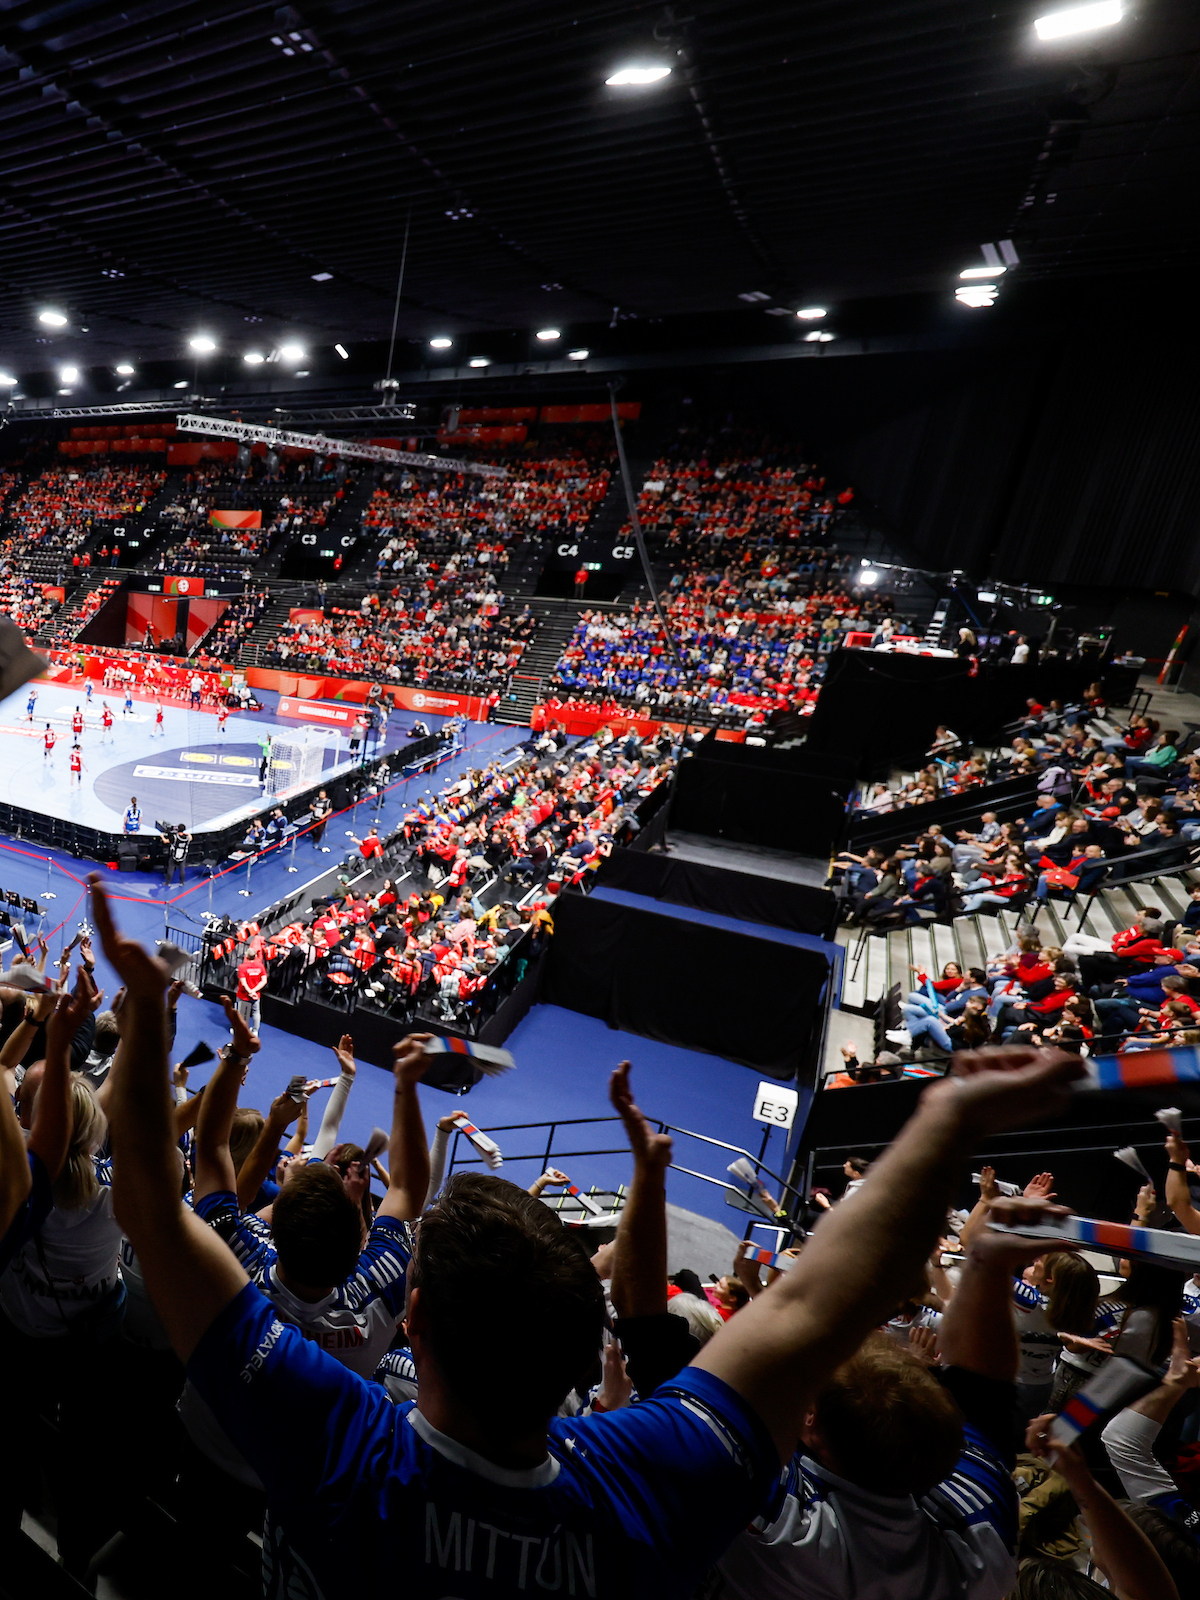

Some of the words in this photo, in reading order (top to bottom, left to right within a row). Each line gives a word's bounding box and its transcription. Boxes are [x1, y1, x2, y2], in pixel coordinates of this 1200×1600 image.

[113, 527, 126, 537] C2
[301, 534, 317, 546] C3
[557, 543, 579, 557] C4
[611, 545, 635, 559] C5
[760, 1101, 789, 1122] E3
[423, 1500, 599, 1600] MITTÚN
